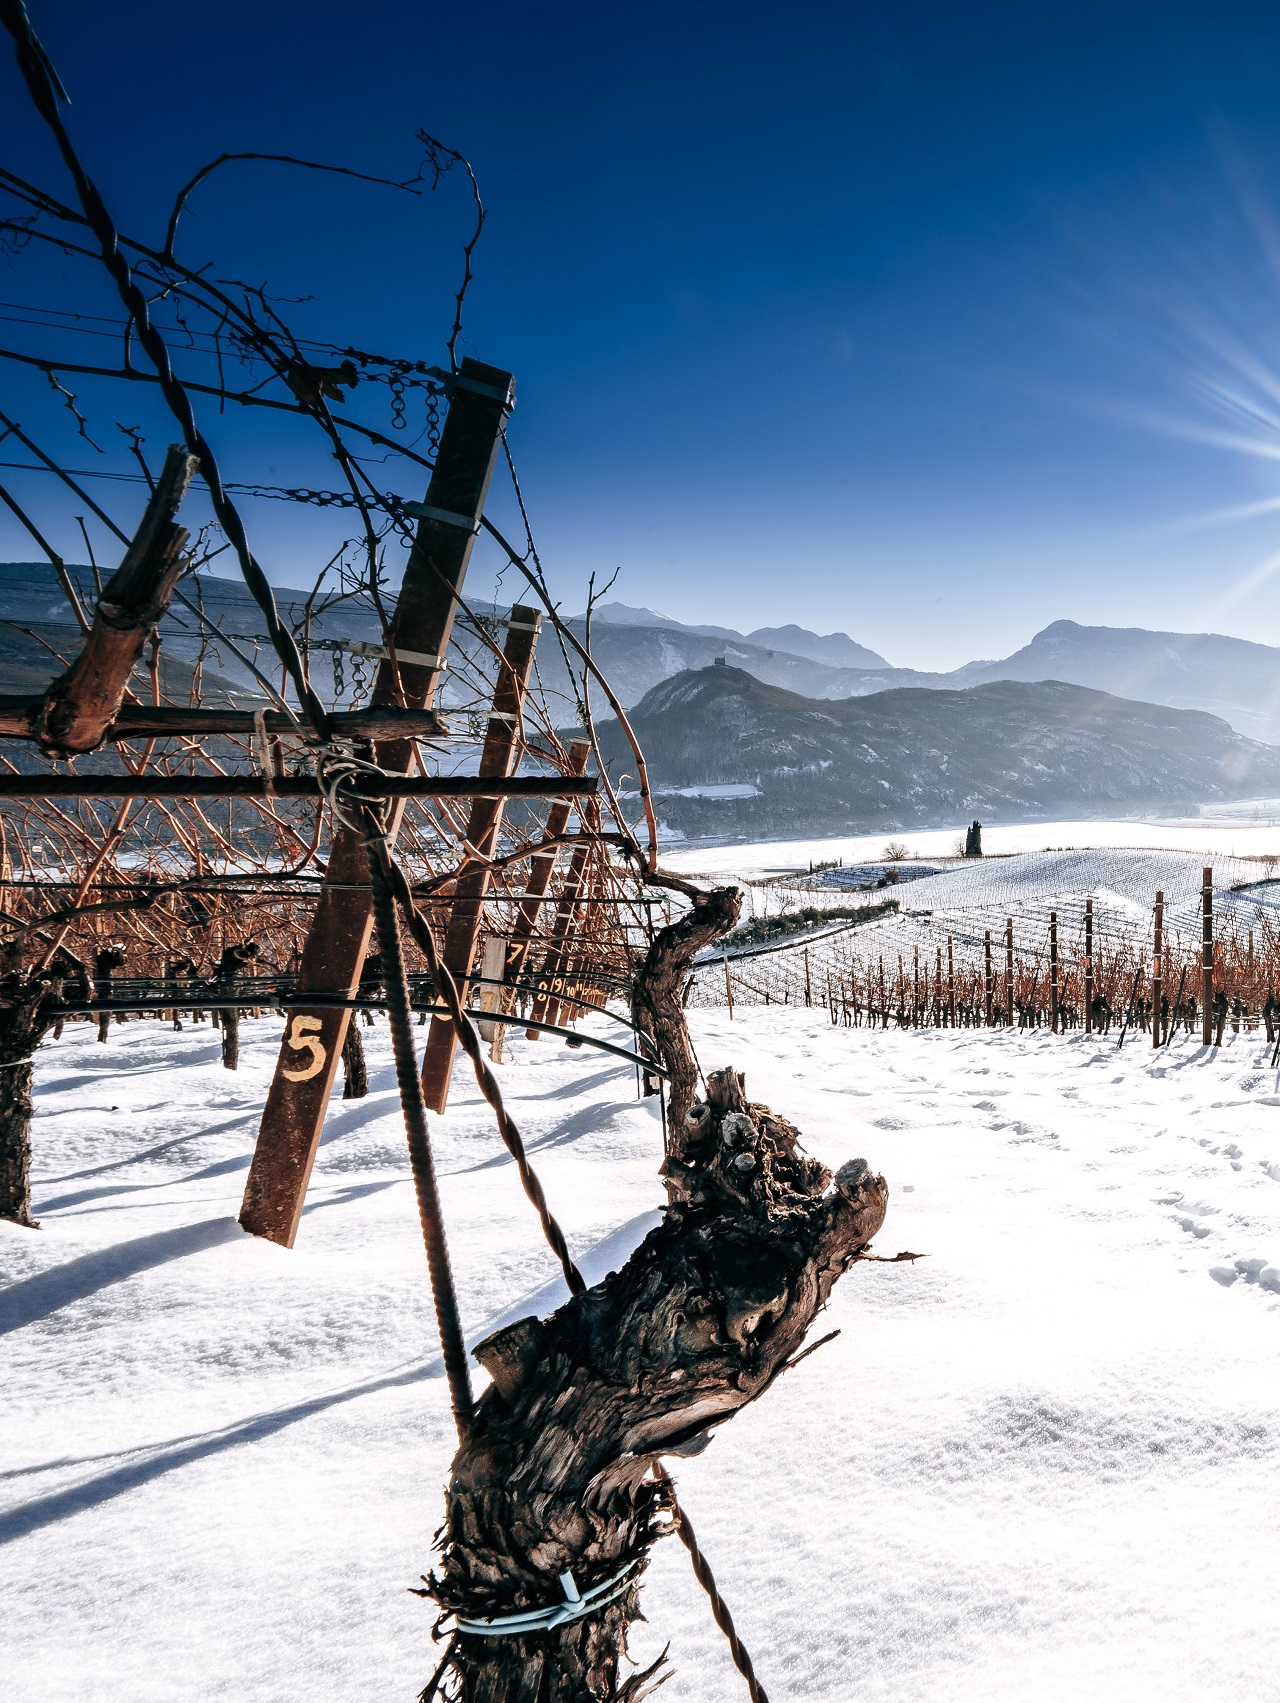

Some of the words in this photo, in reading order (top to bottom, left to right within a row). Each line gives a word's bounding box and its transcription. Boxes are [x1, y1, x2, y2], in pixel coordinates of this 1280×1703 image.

[537, 981, 547, 1001] 8
[555, 979, 562, 992] 9
[566, 986, 574, 996] 10
[282, 1015, 327, 1083] 5
